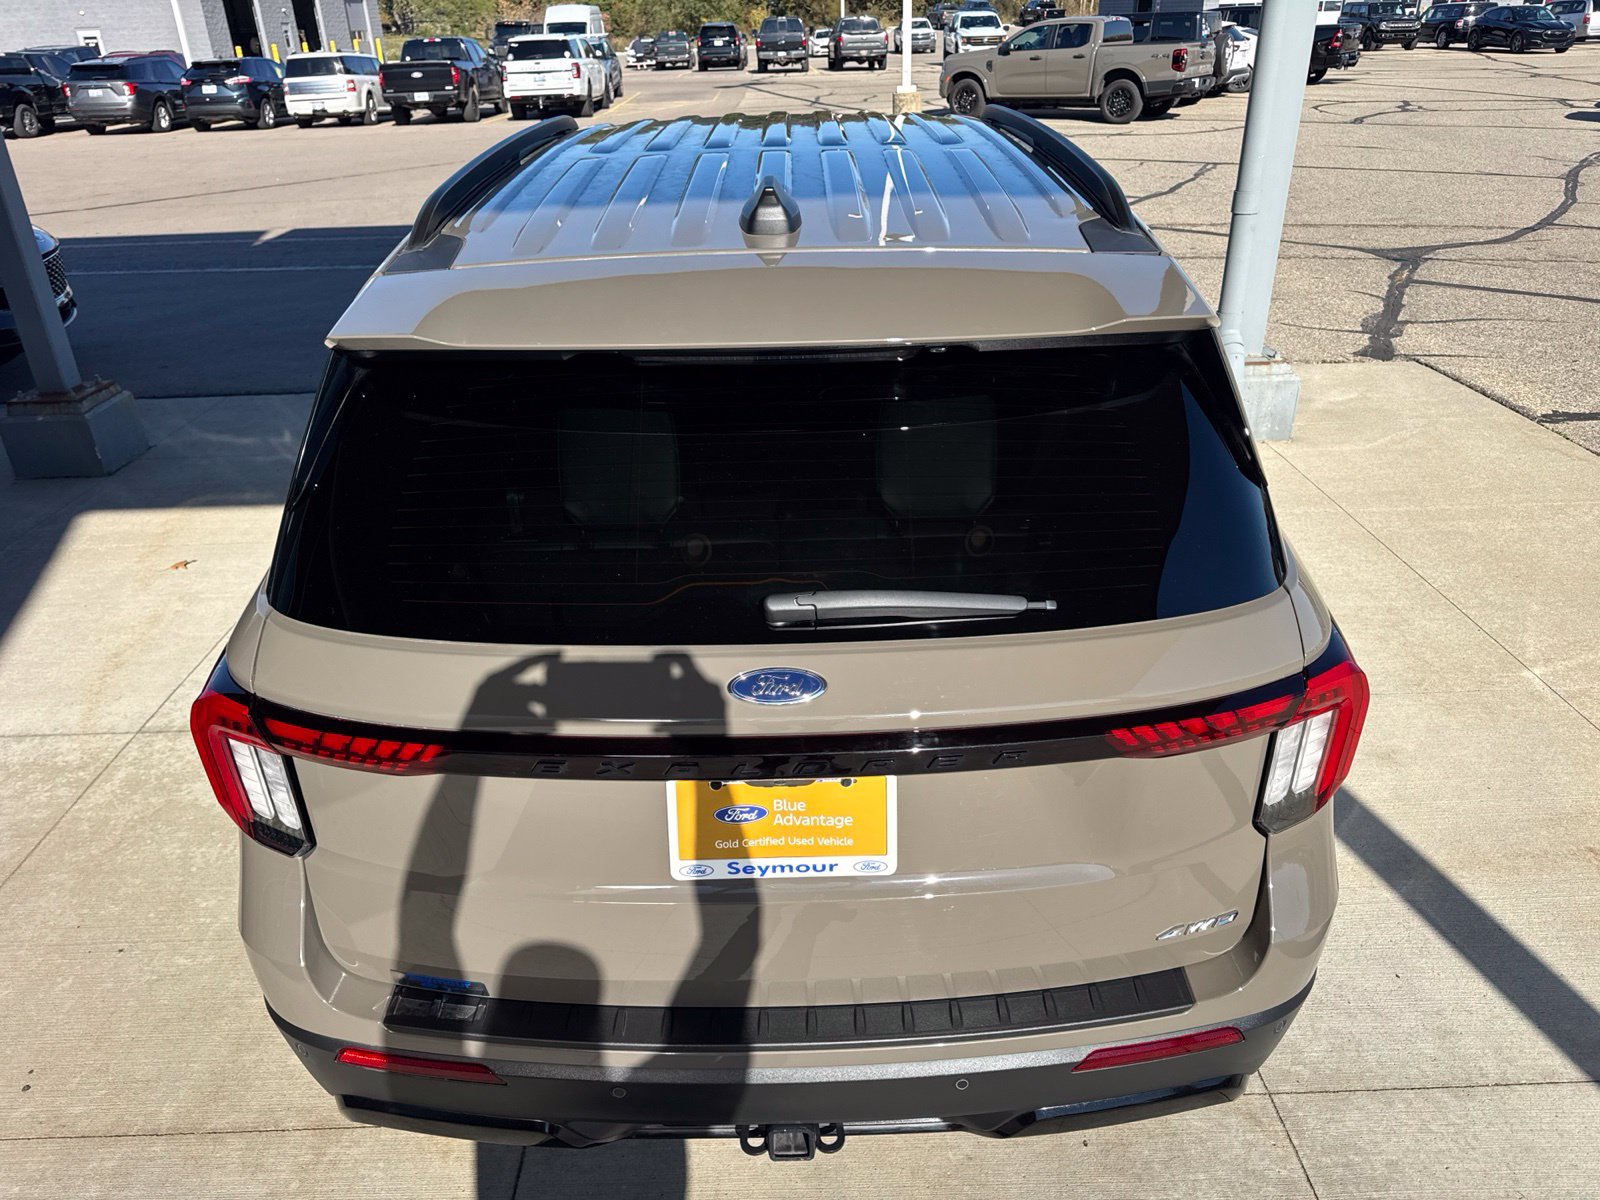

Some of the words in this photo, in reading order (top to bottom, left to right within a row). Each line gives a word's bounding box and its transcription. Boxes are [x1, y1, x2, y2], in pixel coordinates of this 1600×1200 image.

[751, 674, 804, 698] Ford
[773, 799, 806, 812] Blue
[724, 807, 759, 821] Ford
[773, 813, 854, 829] Advantage
[714, 839, 739, 849] Gold
[741, 836, 785, 848] Certified
[787, 836, 815, 847] Used
[817, 836, 855, 847] Vehicle
[686, 865, 708, 875] Ford
[727, 861, 839, 877] Seymour
[859, 861, 882, 872] Ford
[1154, 909, 1239, 941] 4WD
